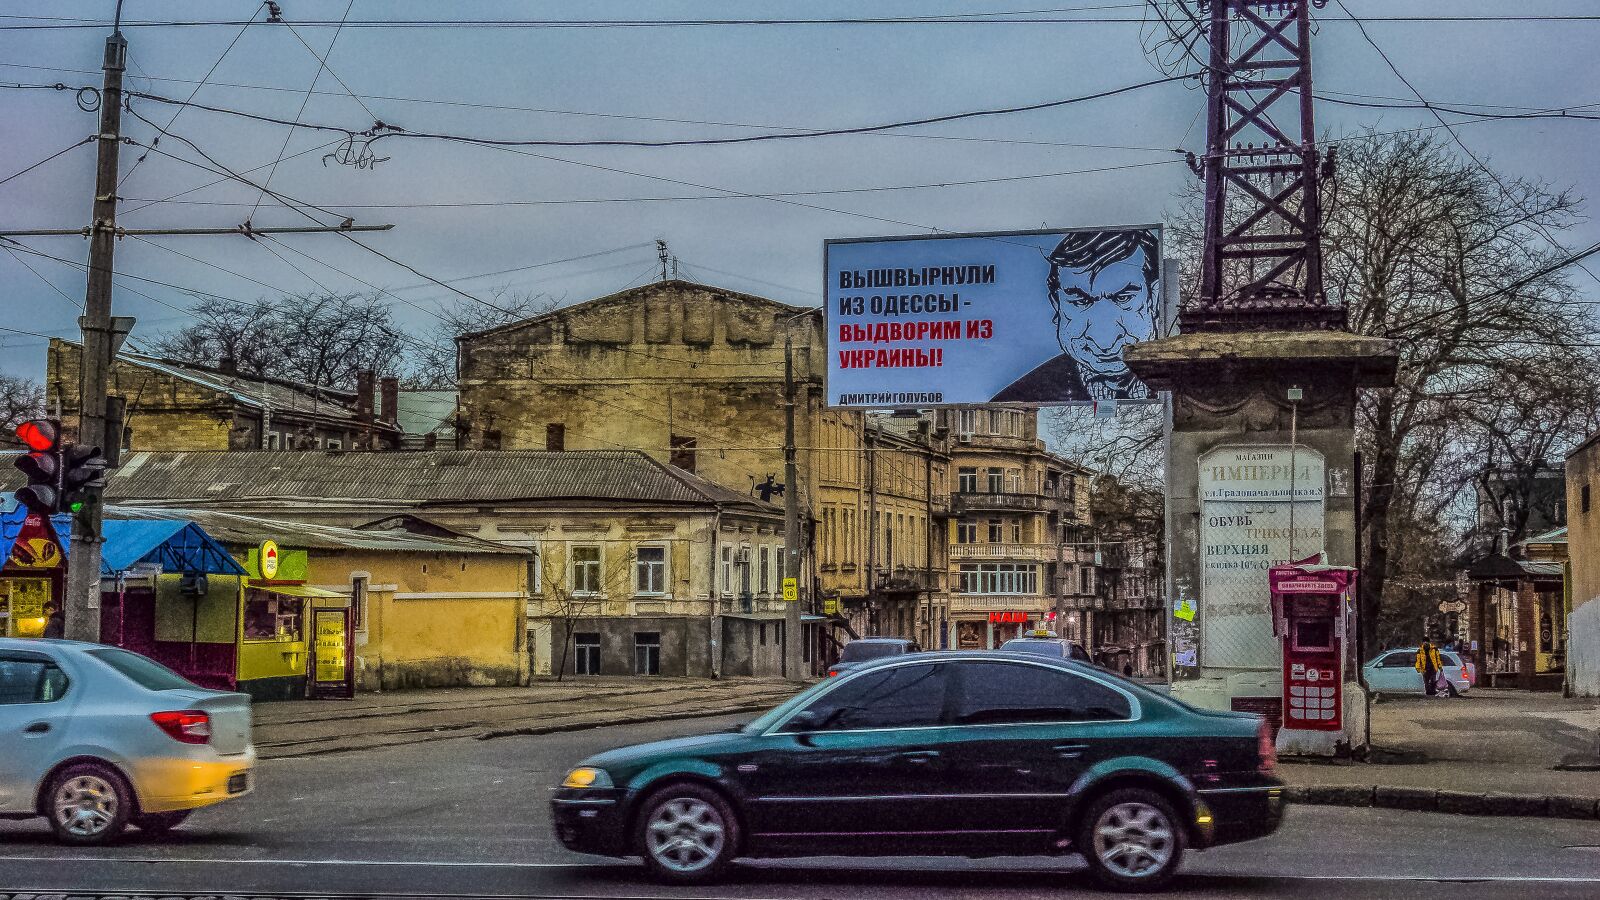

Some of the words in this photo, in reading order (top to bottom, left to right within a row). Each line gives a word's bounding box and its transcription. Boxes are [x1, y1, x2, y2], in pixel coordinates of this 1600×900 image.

[839, 265, 995, 289] ВЫШВЫРНУЛИ
[839, 297, 865, 316] ИЗ
[870, 294, 959, 317] ОДЕССЫ
[839, 321, 961, 343] ВЫДВОРИМ
[966, 319, 993, 339] ИЗ
[839, 348, 943, 369] УКРАИНЫ!
[839, 391, 891, 405] ДМИТРИЙ
[892, 392, 943, 404] ГОЛУБОВ
[1236, 453, 1274, 461] МАГАЗИН
[1209, 516, 1253, 527] ОБУВЬ
[1245, 527, 1322, 539] ТРИКОТАЖ
[1207, 544, 1269, 555] ВЕРХНЯЯ
[989, 611, 1027, 624] НАШ
